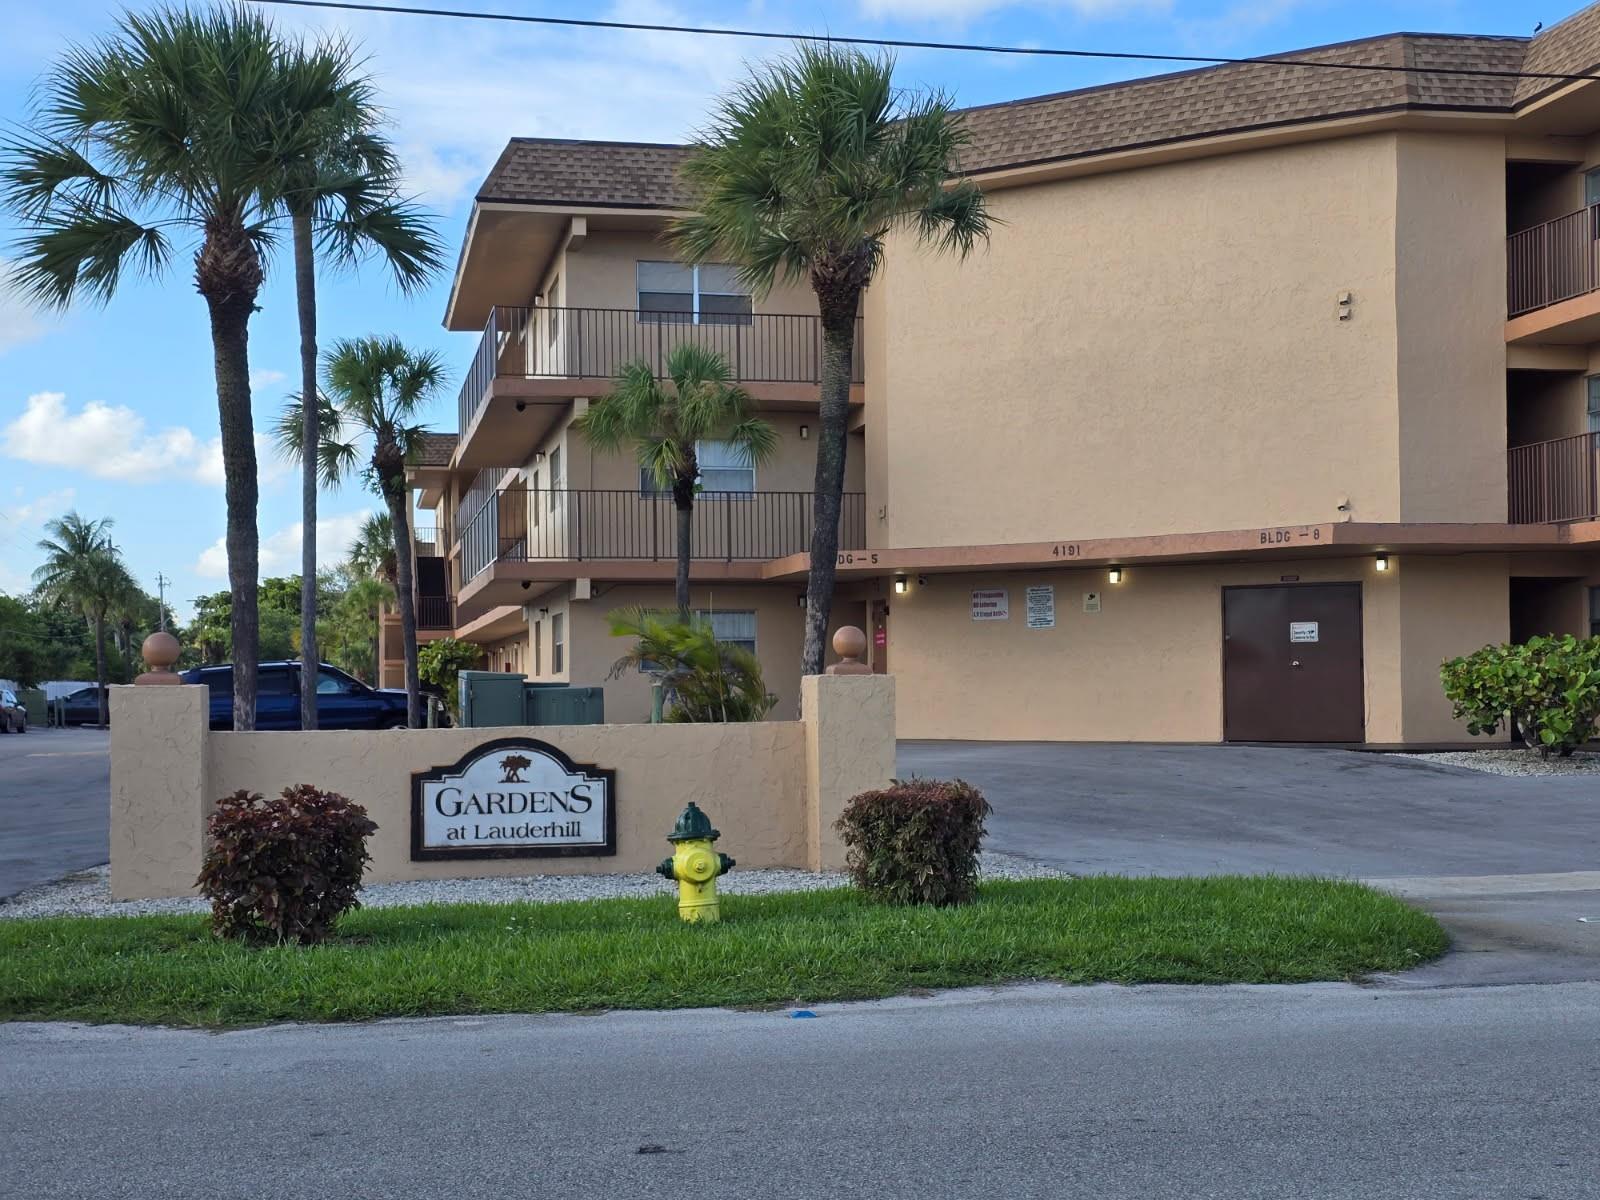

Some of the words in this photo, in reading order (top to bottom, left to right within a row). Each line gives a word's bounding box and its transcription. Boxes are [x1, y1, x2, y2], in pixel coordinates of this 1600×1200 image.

[1260, 531, 1290, 544] BLDG
[1313, 528, 1320, 540] 8
[1052, 544, 1080, 557] 4191
[838, 554, 853, 565] DG
[871, 553, 878, 564] 5
[435, 784, 592, 817] GARDENS
[447, 824, 467, 840] at
[474, 821, 581, 840] Lauderhill
